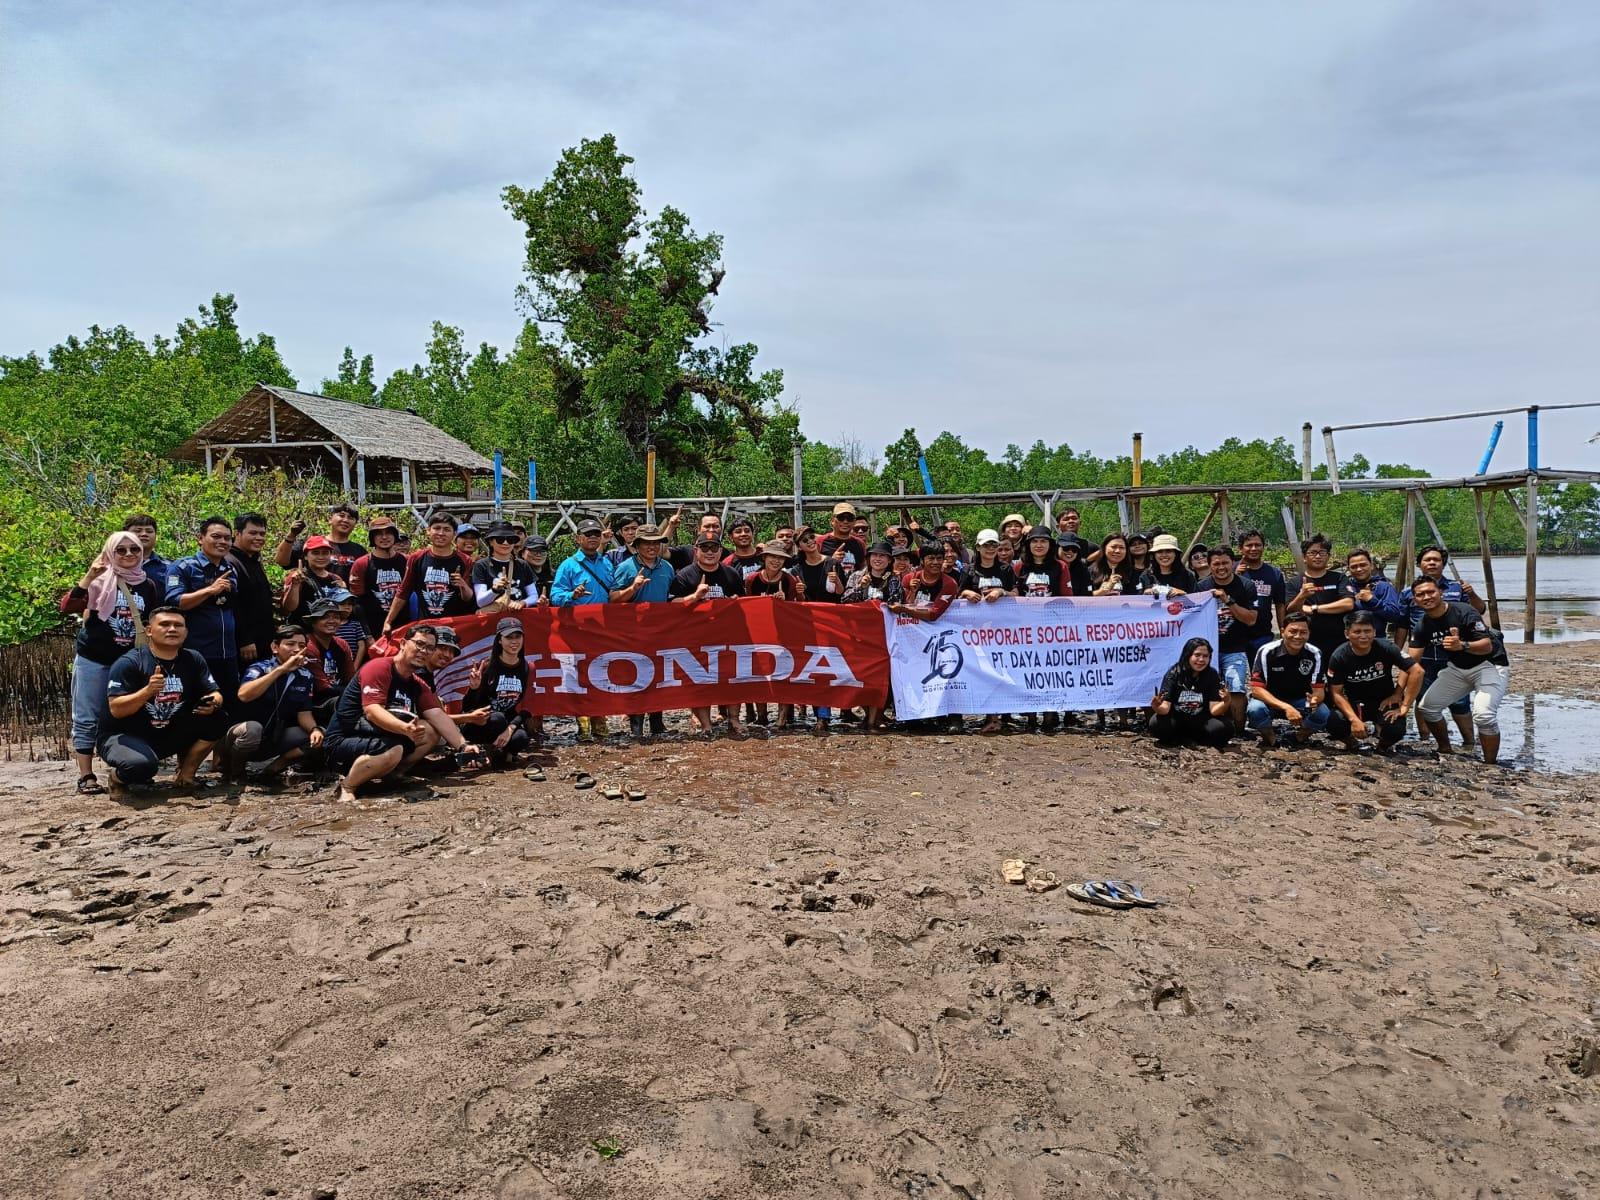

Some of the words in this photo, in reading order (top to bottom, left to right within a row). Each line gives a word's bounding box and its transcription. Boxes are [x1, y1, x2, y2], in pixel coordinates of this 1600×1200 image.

[962, 628, 1032, 646] CORPORATE
[1037, 624, 1083, 643] SOCIAL
[1086, 619, 1184, 642] RESPONSIBILITY
[525, 645, 864, 694] HONDA
[992, 650, 1008, 669] PT.
[1011, 649, 1041, 668] DAYA
[1045, 648, 1099, 666] ADICIPTA
[1104, 646, 1147, 664] WISESA
[1024, 671, 1075, 690] MOVING
[1079, 669, 1114, 687] AGILE
